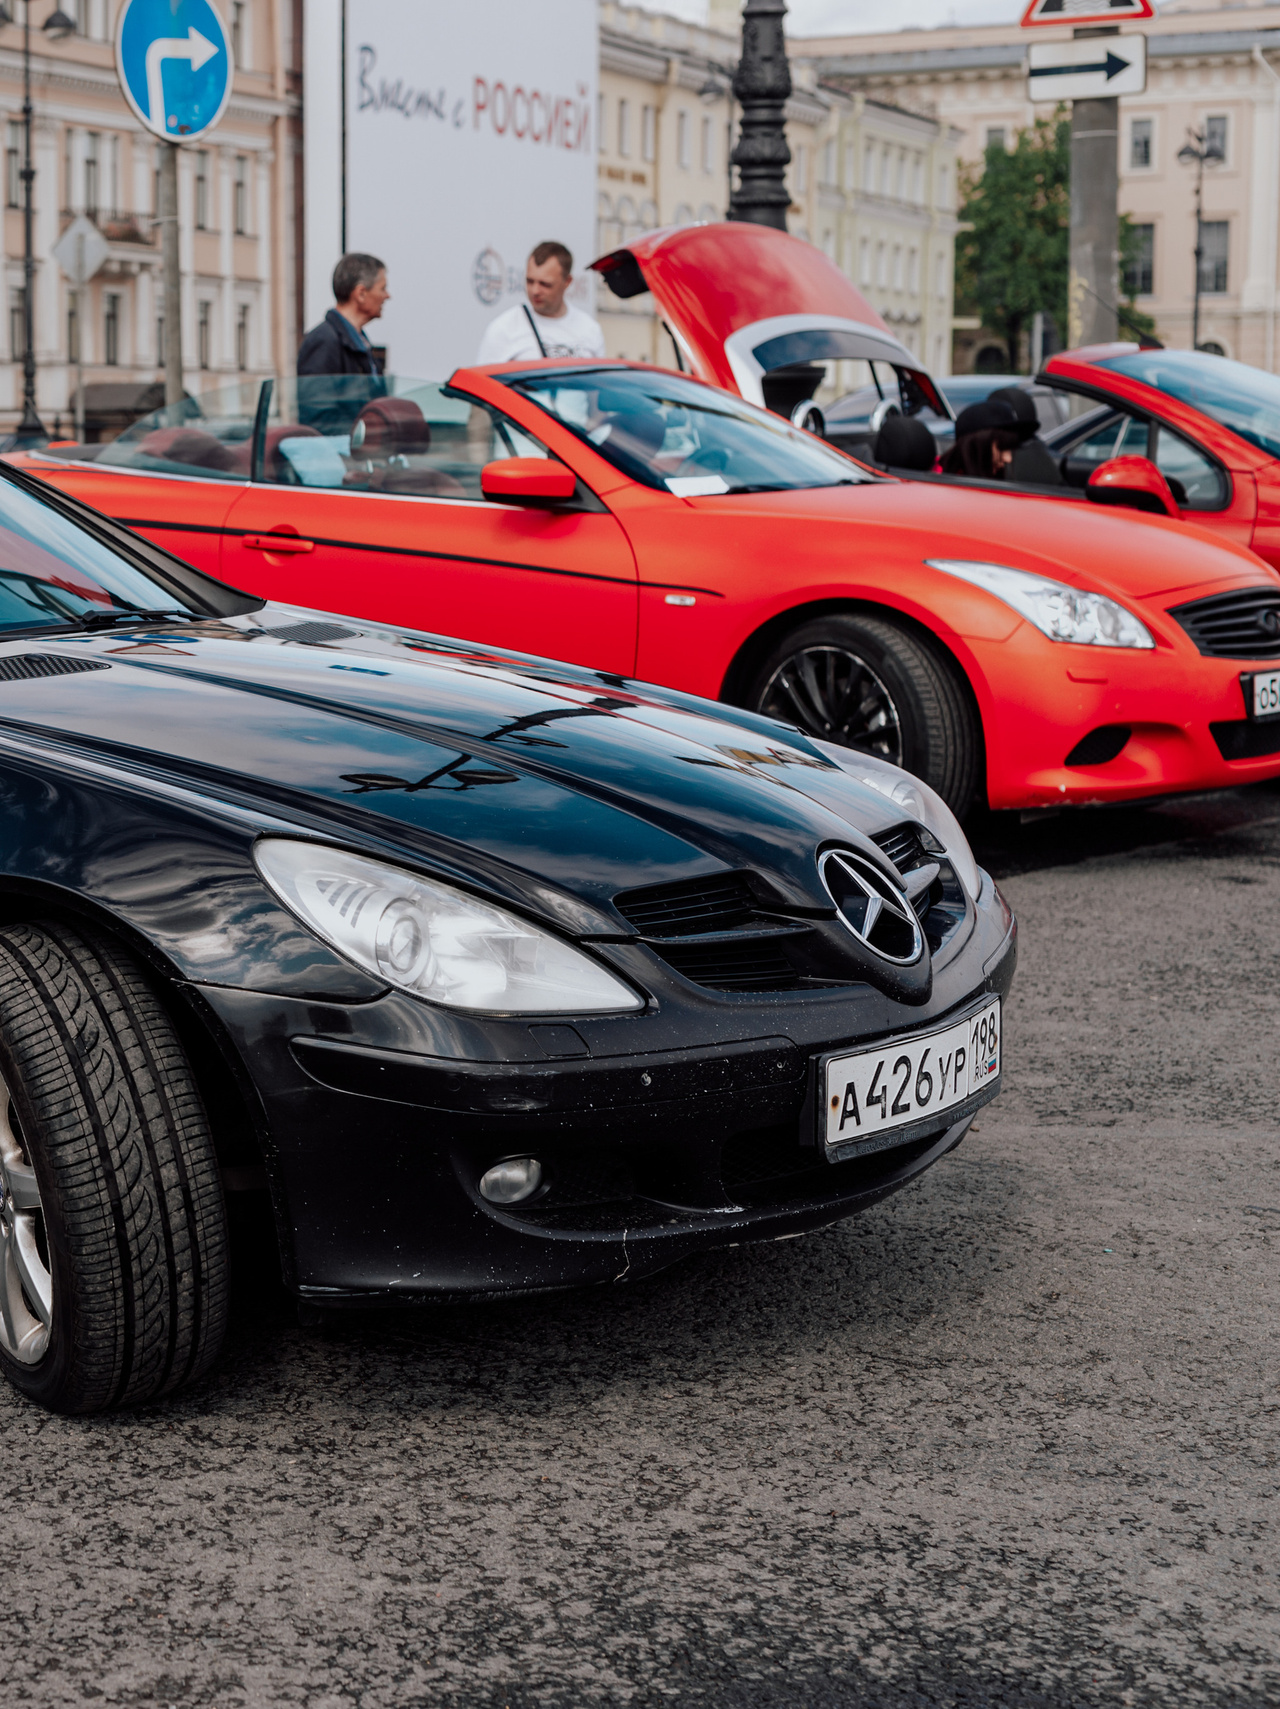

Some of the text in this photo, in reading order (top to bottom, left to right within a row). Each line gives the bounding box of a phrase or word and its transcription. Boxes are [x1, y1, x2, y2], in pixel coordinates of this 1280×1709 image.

[357, 44, 592, 154] Вместе с РОССИЕЙ
[1260, 678, 1280, 709] О5
[838, 1047, 966, 1131] А426УР
[972, 1011, 997, 1065] 198
[974, 1060, 988, 1080] RUS
